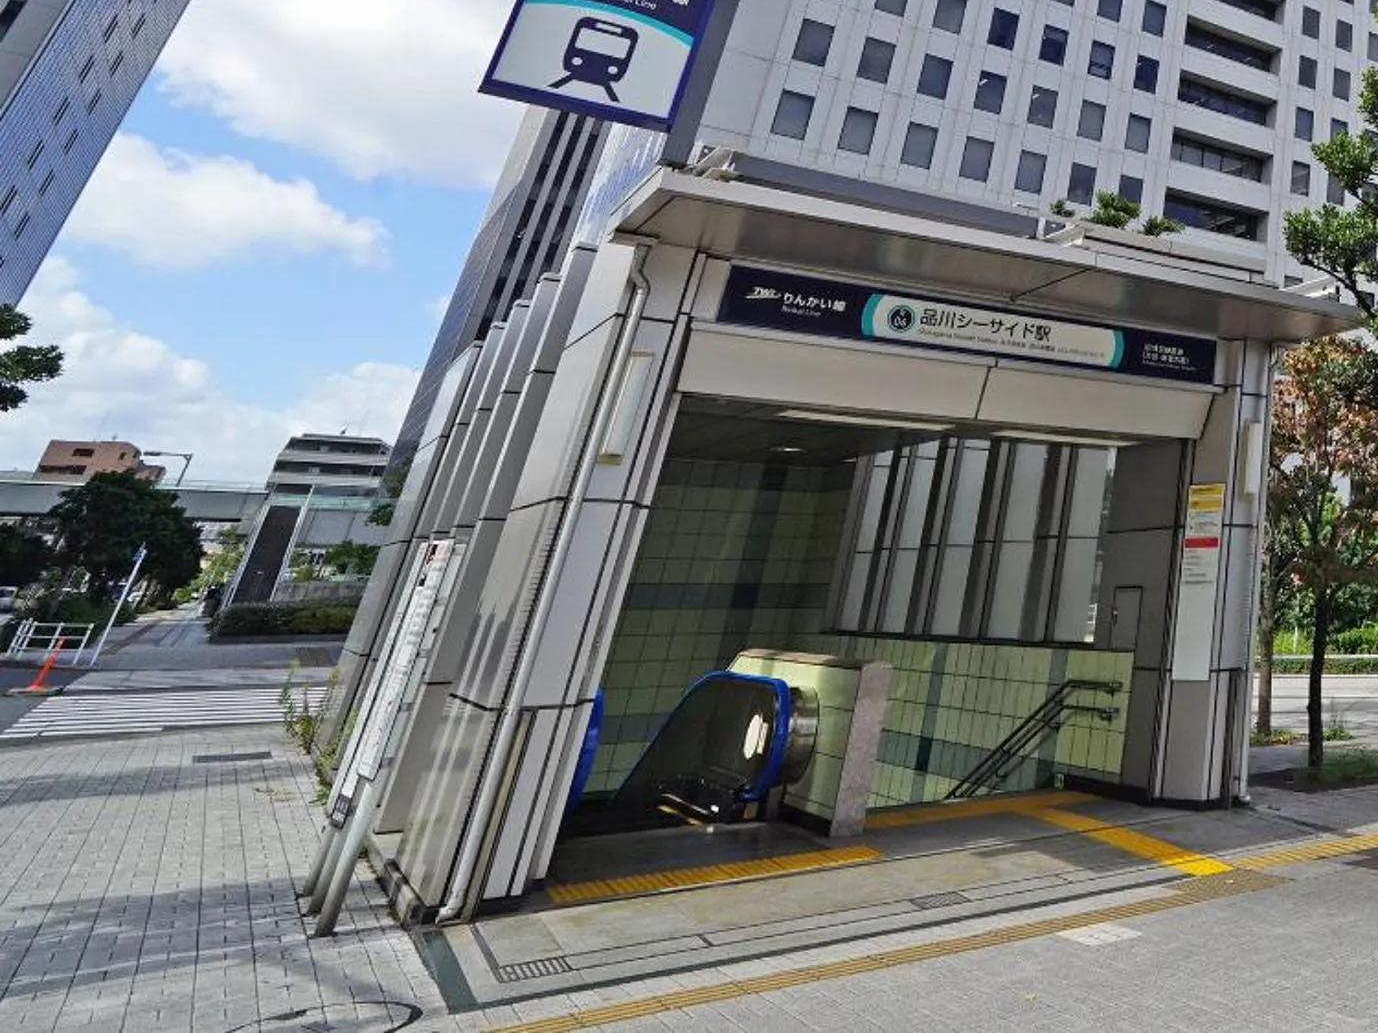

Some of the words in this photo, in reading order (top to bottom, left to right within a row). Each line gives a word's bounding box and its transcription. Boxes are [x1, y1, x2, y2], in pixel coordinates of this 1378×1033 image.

[783, 292, 847, 312] りんかい線
[920, 308, 1052, 343] 品川シーサイド駅
